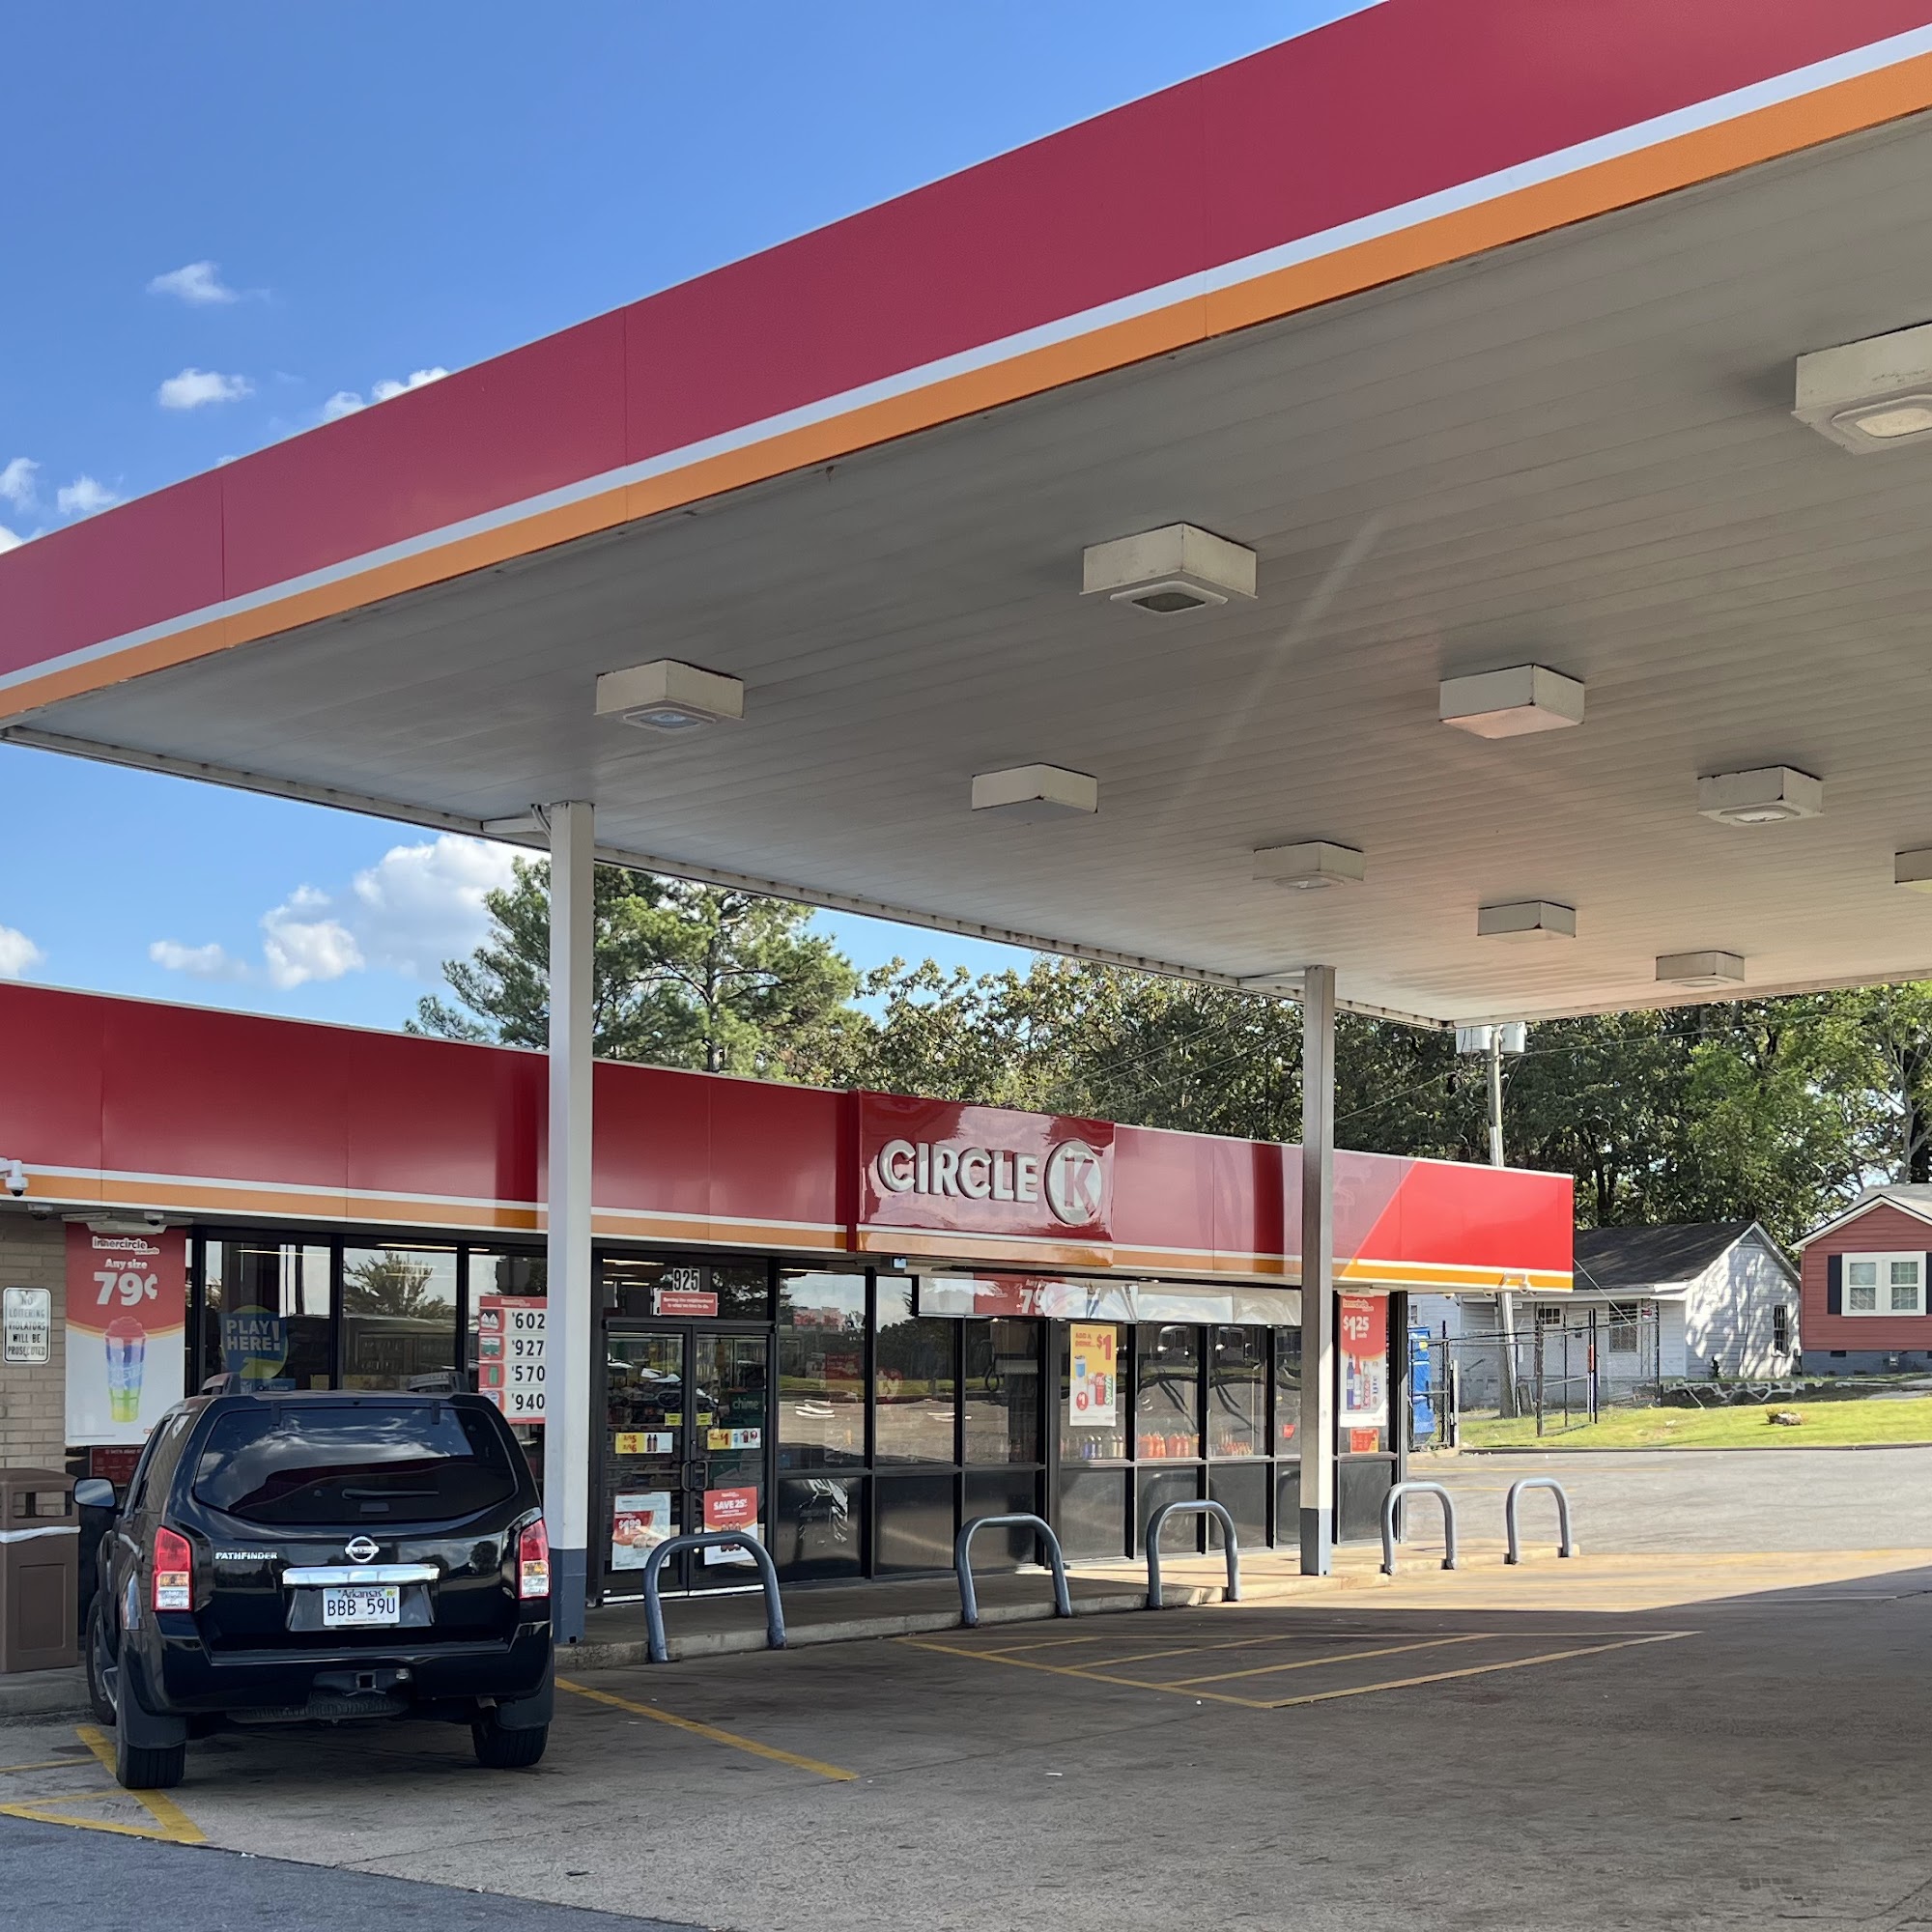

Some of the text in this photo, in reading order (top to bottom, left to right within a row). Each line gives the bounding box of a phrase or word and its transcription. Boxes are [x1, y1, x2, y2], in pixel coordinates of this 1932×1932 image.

[878, 1140, 1099, 1221] CIRCLE K
[94, 1237, 146, 1249] innercircle
[105, 1259, 148, 1270] Any size
[674, 1269, 698, 1291] 925
[94, 1272, 157, 1306] 79¢
[21, 1295, 33, 1305] NO
[9, 1308, 45, 1319] LOITERING
[9, 1321, 45, 1330] VIOLATORS
[226, 1320, 270, 1335] PLAY
[14, 1333, 41, 1343] WILL BE
[8, 1346, 45, 1356] PROSECUTED
[732, 1398, 759, 1409] chime
[713, 1500, 734, 1511] SAVE
[214, 1551, 278, 1560] PATHFINDER
[342, 1589, 383, 1599] Arkansas
[327, 1598, 395, 1616] BBB 59U
